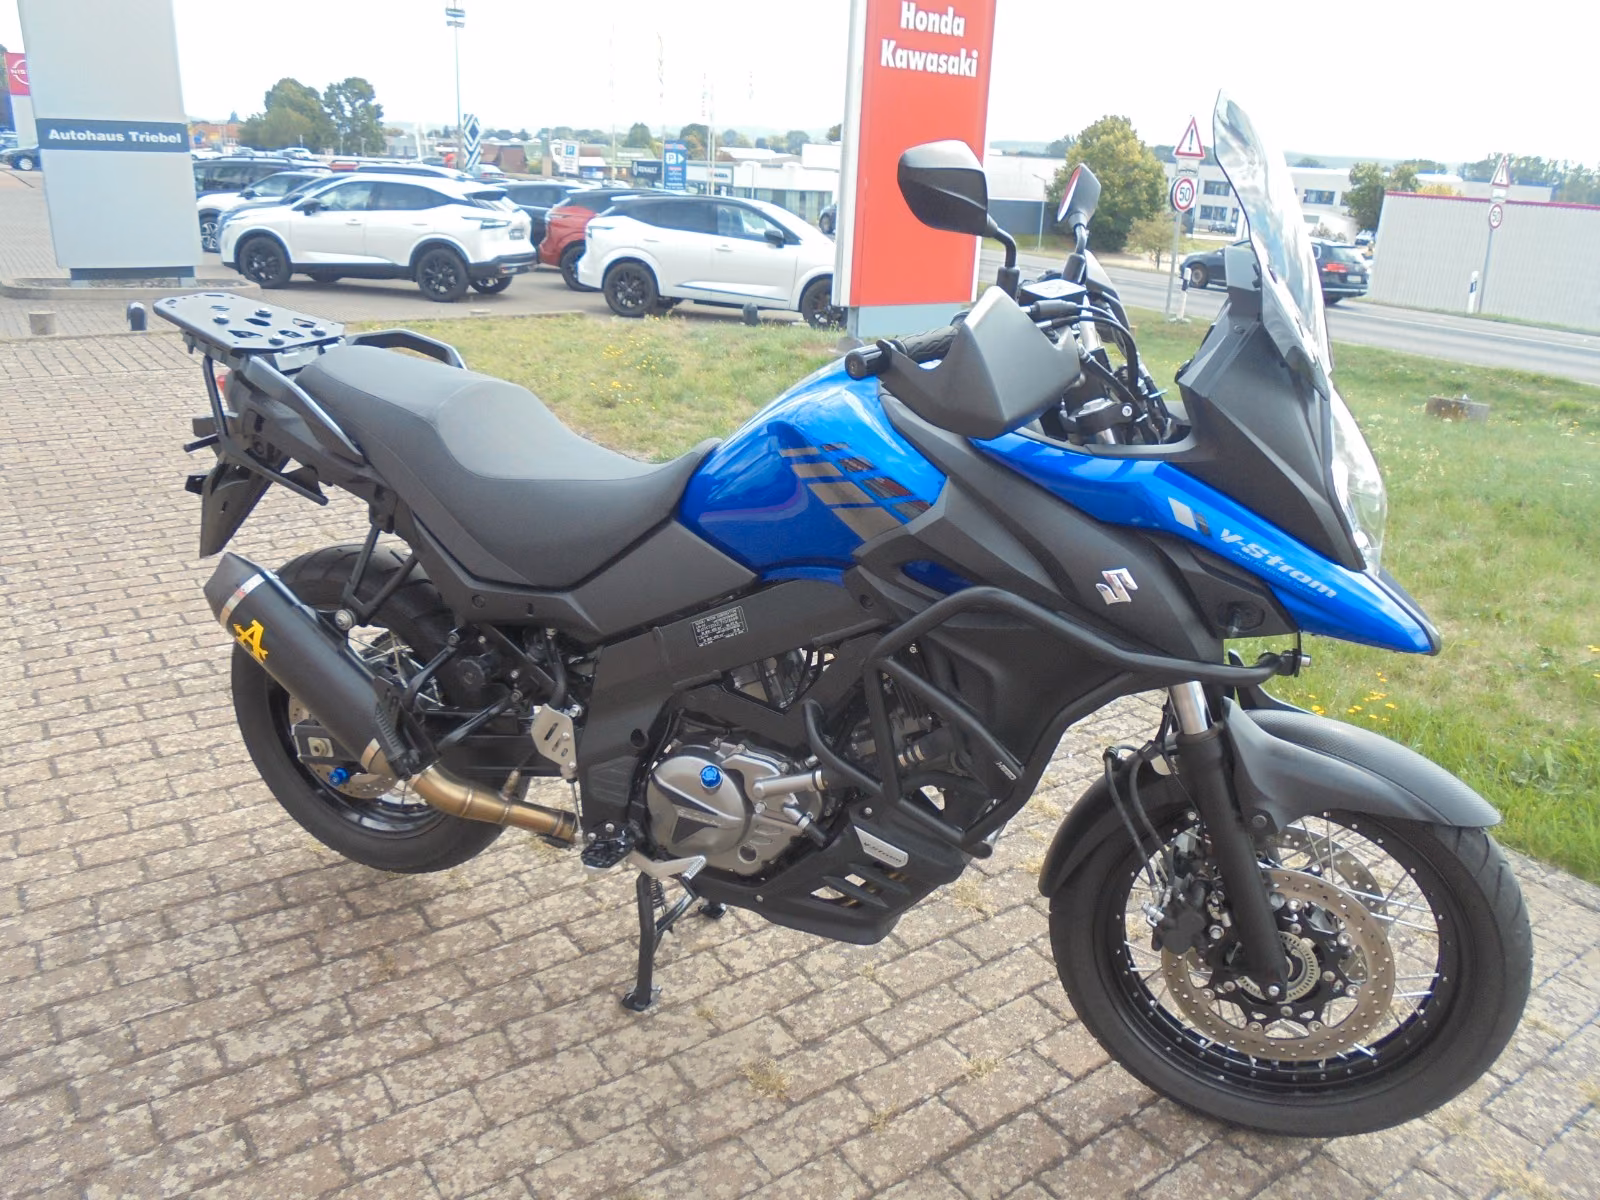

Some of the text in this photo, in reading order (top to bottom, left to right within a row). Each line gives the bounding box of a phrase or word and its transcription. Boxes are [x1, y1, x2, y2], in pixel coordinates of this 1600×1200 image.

[900, 0, 965, 37] Honda
[880, 39, 978, 77] Kawasaki
[48, 129, 182, 144] Autohaus Triebel
[1179, 187, 1191, 202] 50
[1492, 210, 1501, 223] 50
